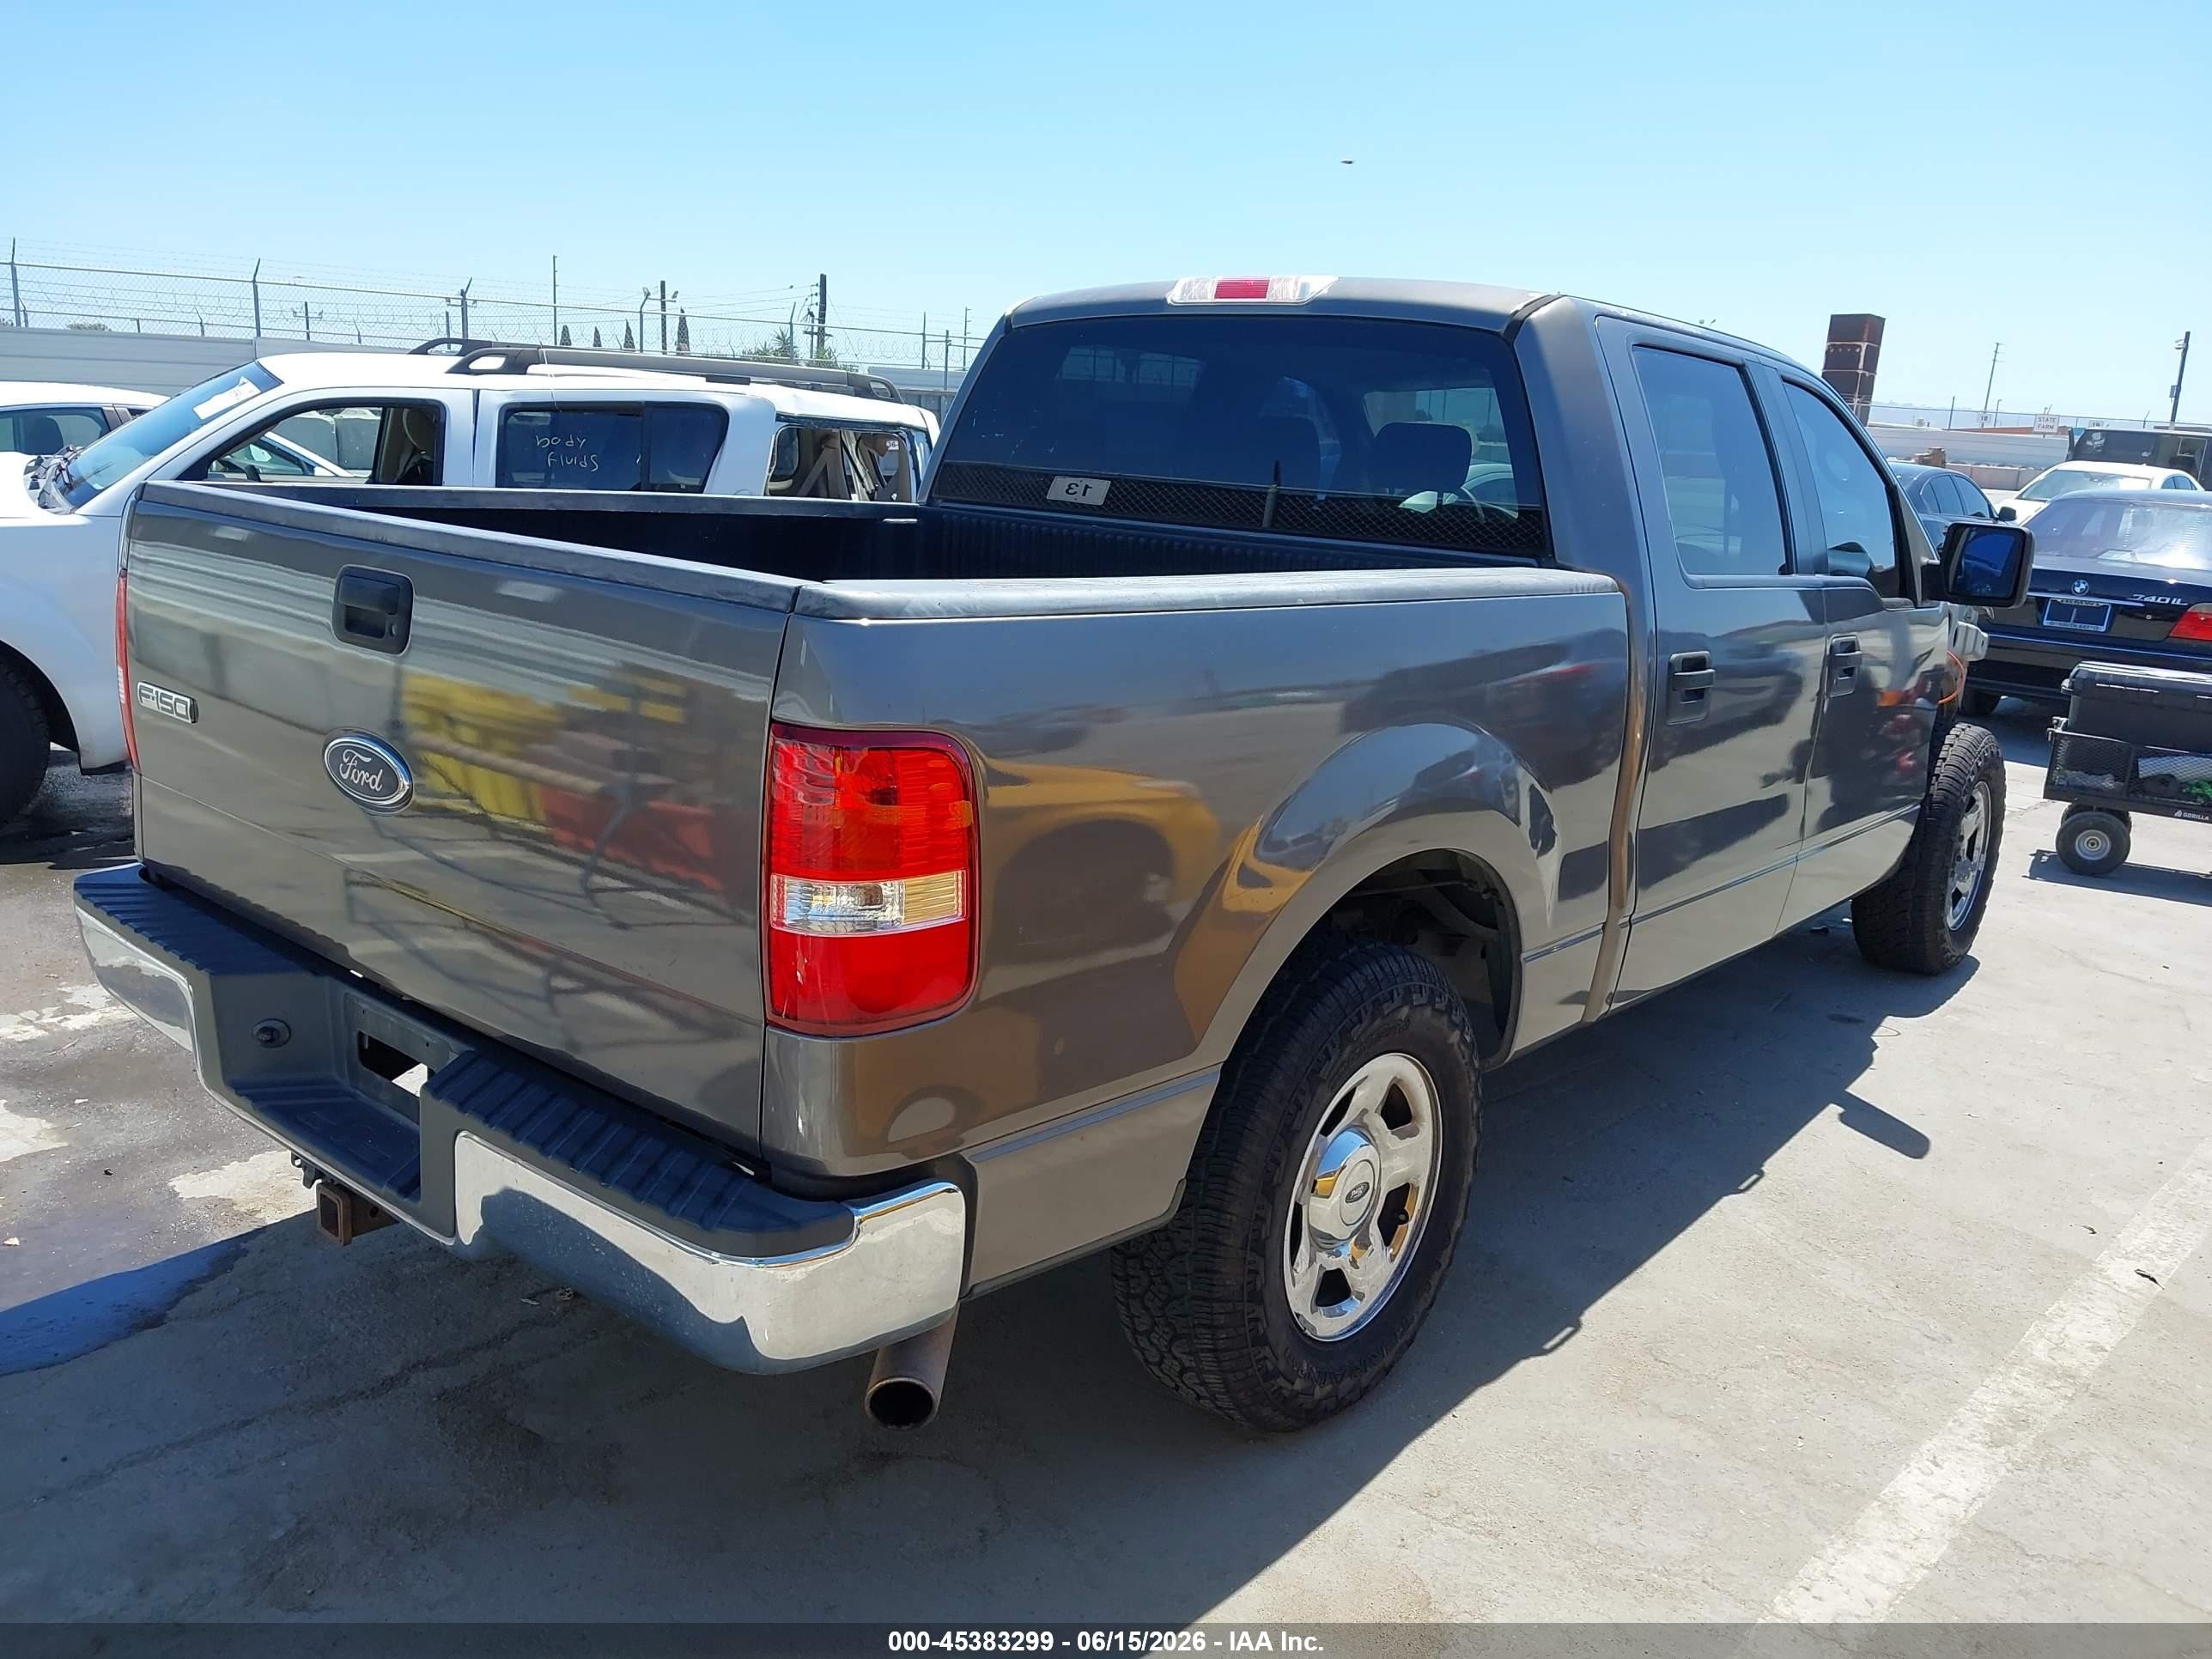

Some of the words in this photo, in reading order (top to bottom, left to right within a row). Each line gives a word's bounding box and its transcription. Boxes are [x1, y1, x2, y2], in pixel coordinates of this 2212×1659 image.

[536, 434, 586, 448] body
[339, 749, 383, 791] Ford
[2183, 811, 2209, 821] GORILLA
